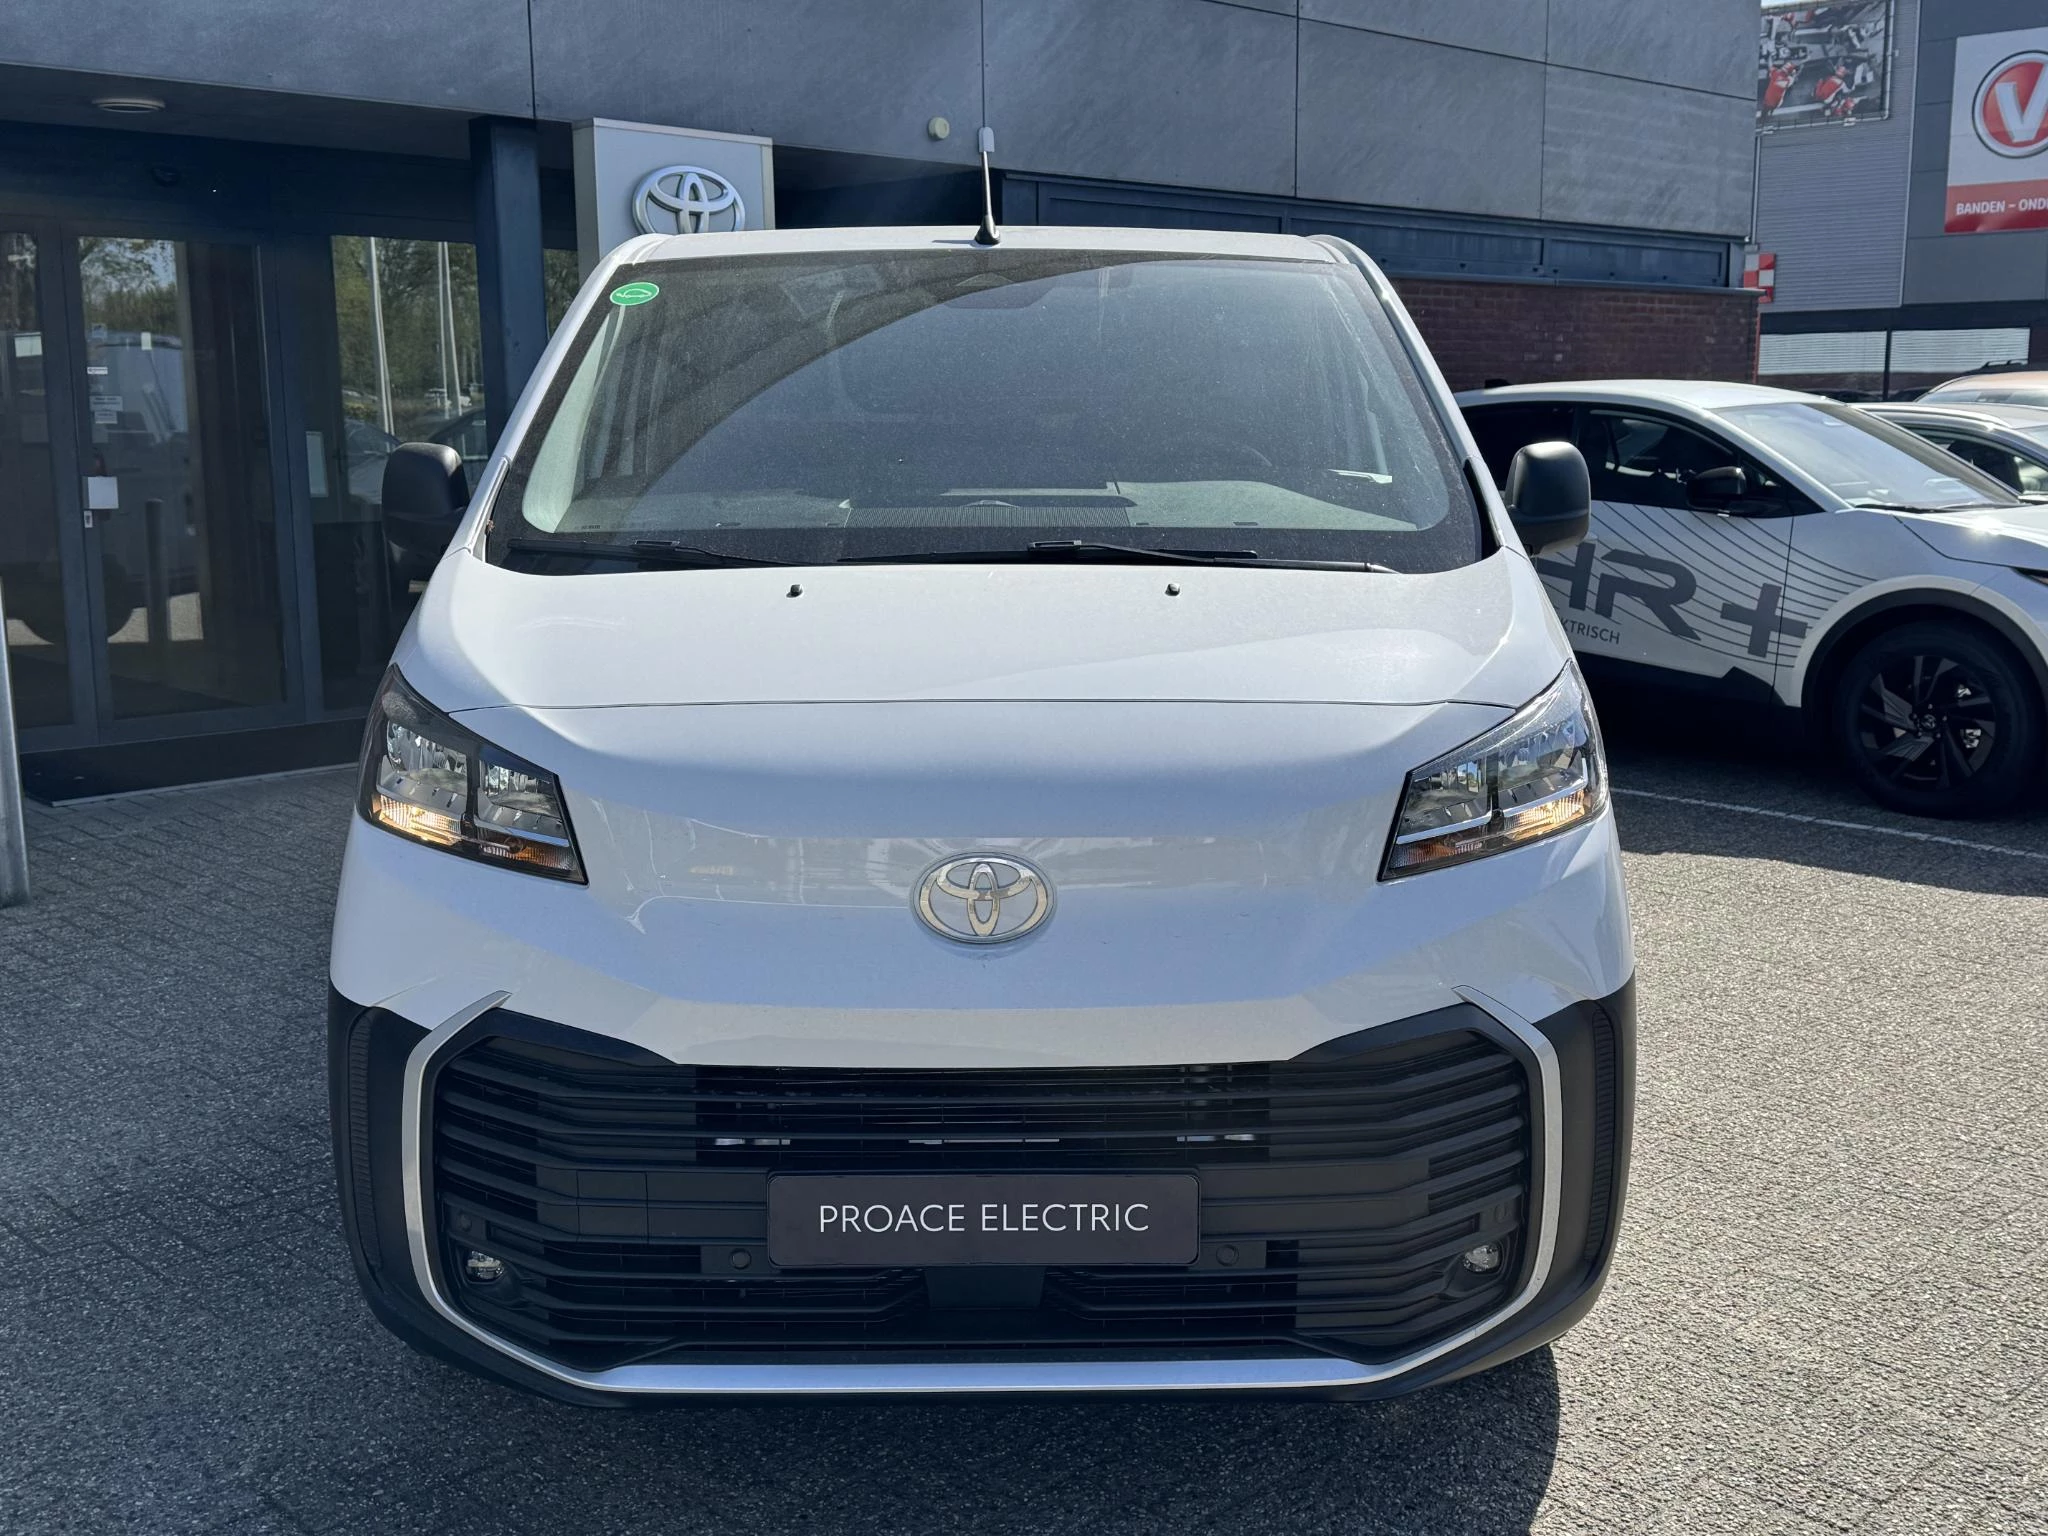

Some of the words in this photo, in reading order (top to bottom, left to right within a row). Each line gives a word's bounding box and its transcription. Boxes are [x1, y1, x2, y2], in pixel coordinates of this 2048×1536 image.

[1995, 63, 2048, 143] V
[1956, 200, 2006, 215] BANDEN
[2018, 197, 2048, 211] OND
[819, 1203, 966, 1233] PROACE
[981, 1203, 1150, 1232] ELECTRIC
